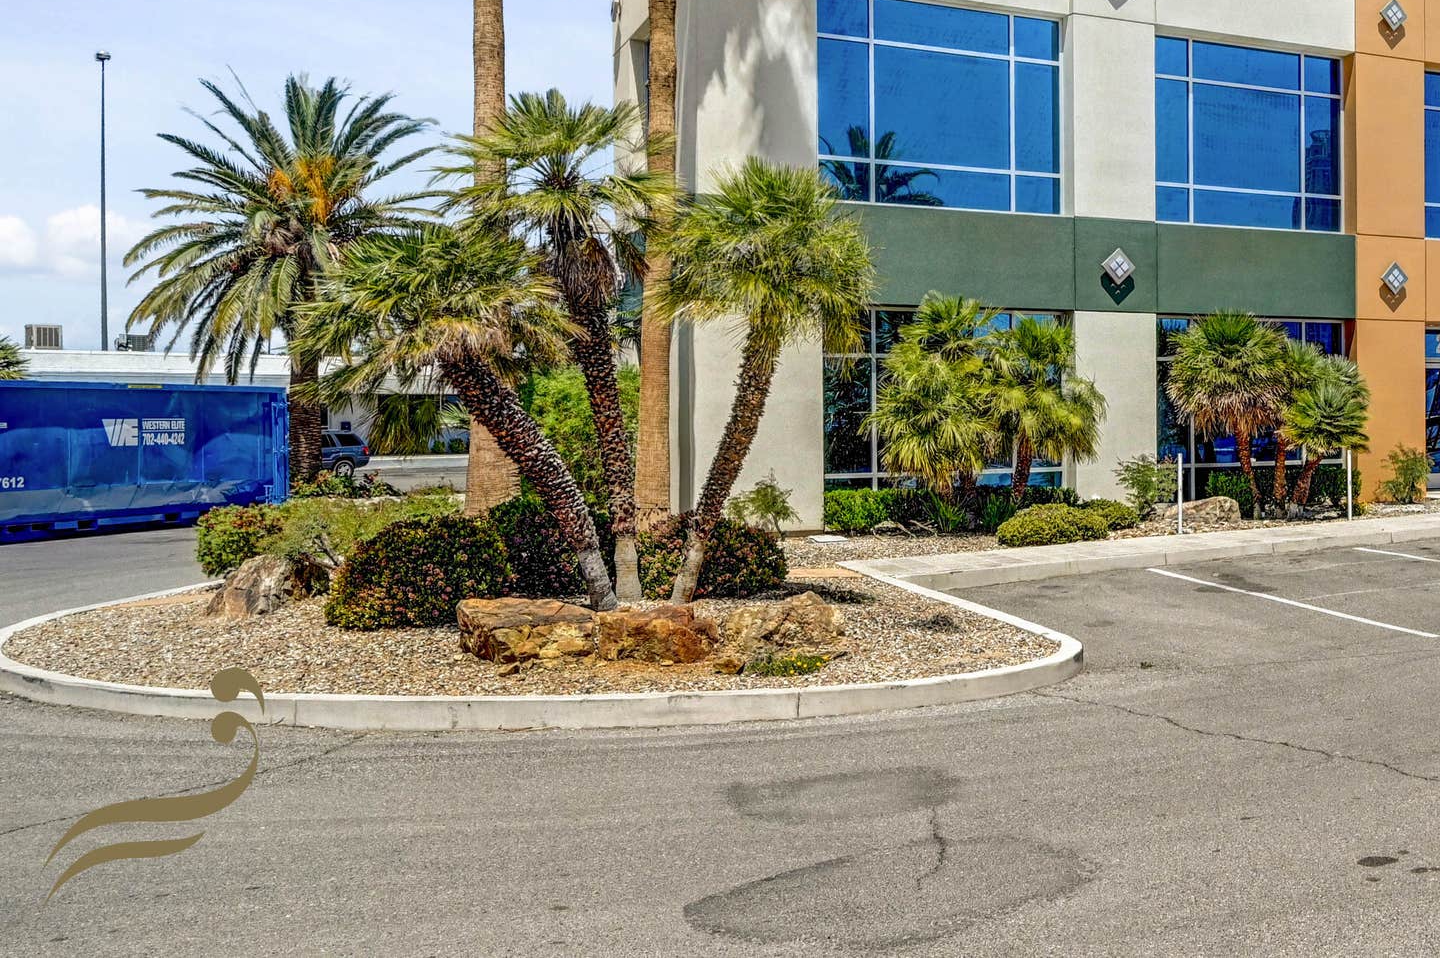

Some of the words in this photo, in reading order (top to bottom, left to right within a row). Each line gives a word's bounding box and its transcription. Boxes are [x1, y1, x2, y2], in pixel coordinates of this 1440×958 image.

[142, 420, 170, 430] WESTERN
[171, 420, 185, 430] ELITE
[142, 433, 184, 445] 702-440-4242
[0, 477, 24, 488] 612
